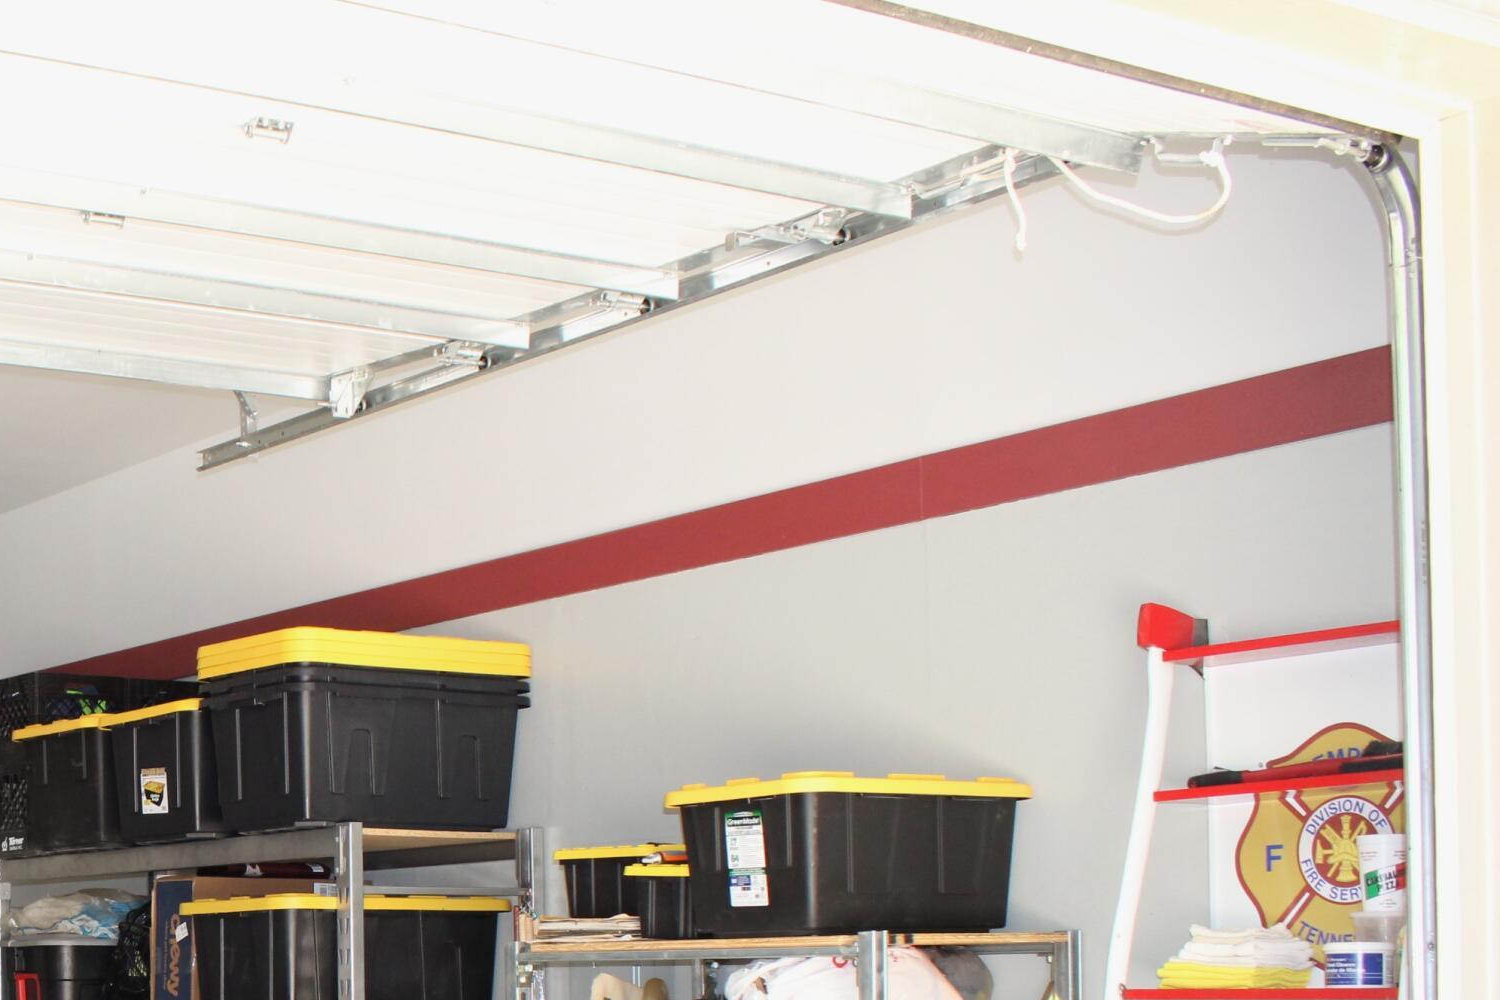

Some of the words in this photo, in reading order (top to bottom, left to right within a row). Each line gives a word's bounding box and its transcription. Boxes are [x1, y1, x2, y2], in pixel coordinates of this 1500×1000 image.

[1305, 799, 1365, 836] DIVISION
[1368, 810, 1388, 829] OF
[1265, 844, 1284, 872] F
[1301, 858, 1326, 892] FIRE
